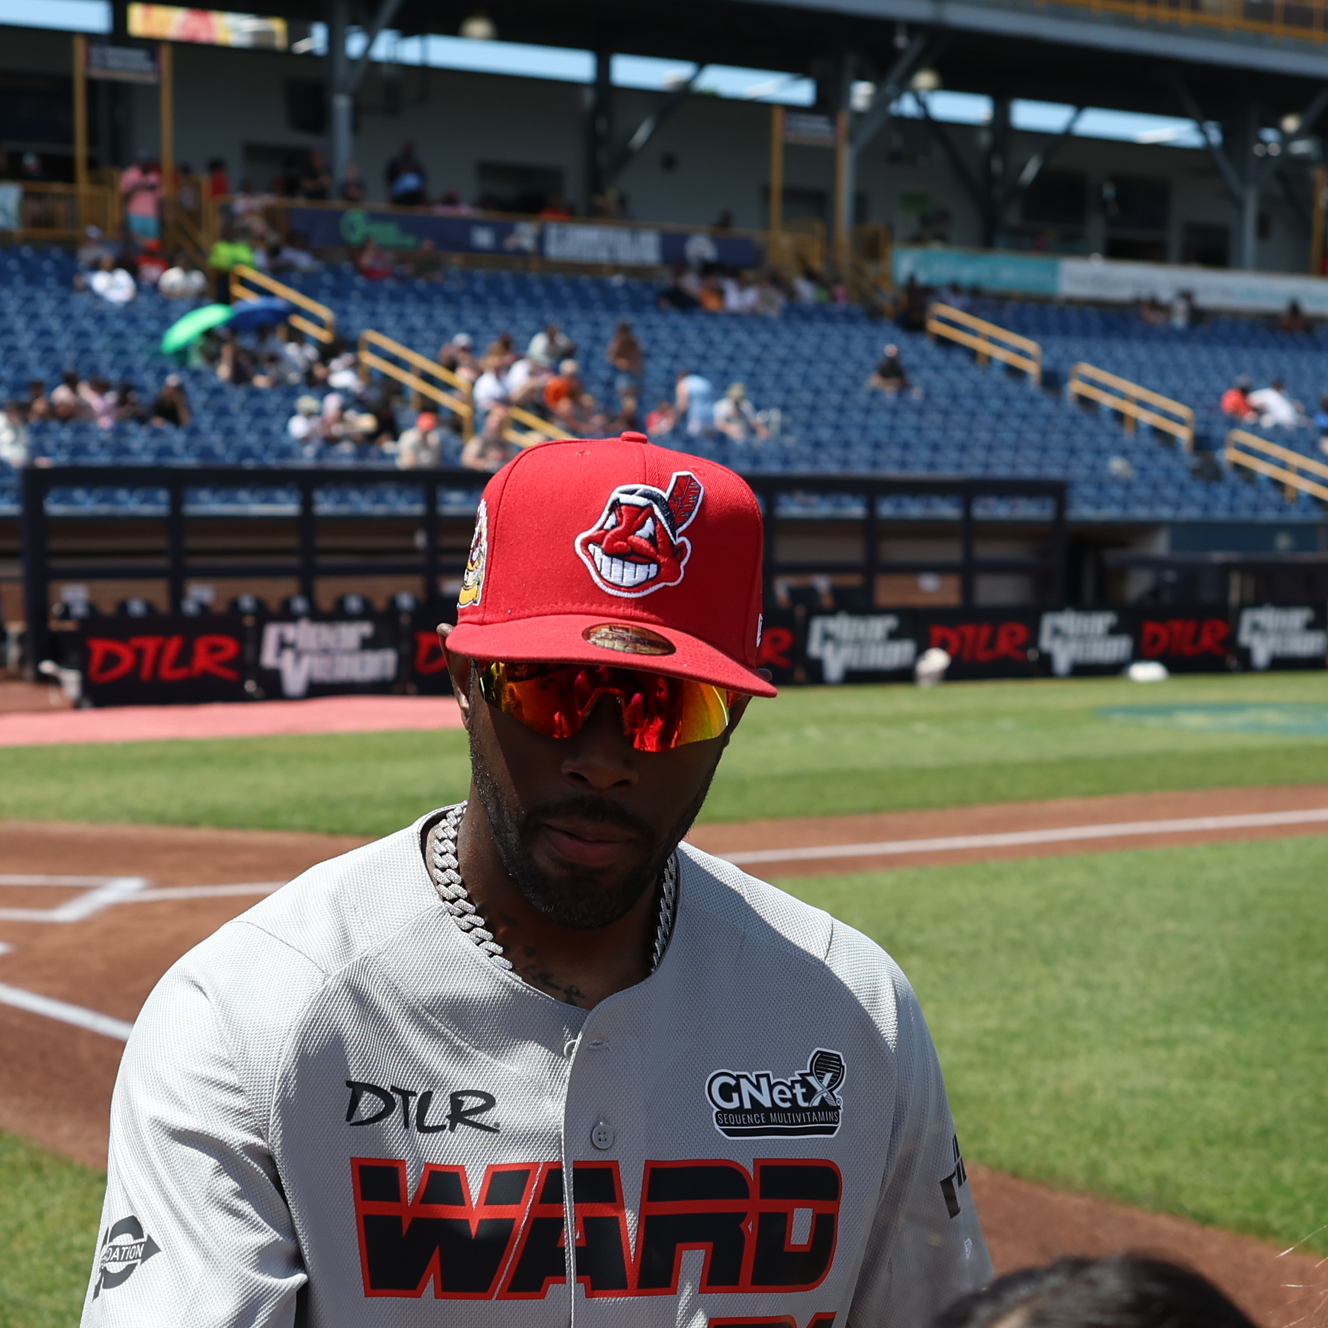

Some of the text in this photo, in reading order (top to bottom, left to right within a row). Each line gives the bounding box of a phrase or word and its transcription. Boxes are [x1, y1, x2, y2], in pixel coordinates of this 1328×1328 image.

[86, 634, 241, 683] DTLR
[260, 618, 374, 669] Clear
[928, 621, 1030, 662] DTLR
[1141, 618, 1230, 657] DTLR
[346, 1081, 500, 1134] DTLR
[711, 1066, 839, 1110] GNetX
[717, 1110, 839, 1125] SEQUENCE MULTIVITAMINS
[349, 1156, 843, 1300] WARD
[104, 1243, 145, 1262] DATION
